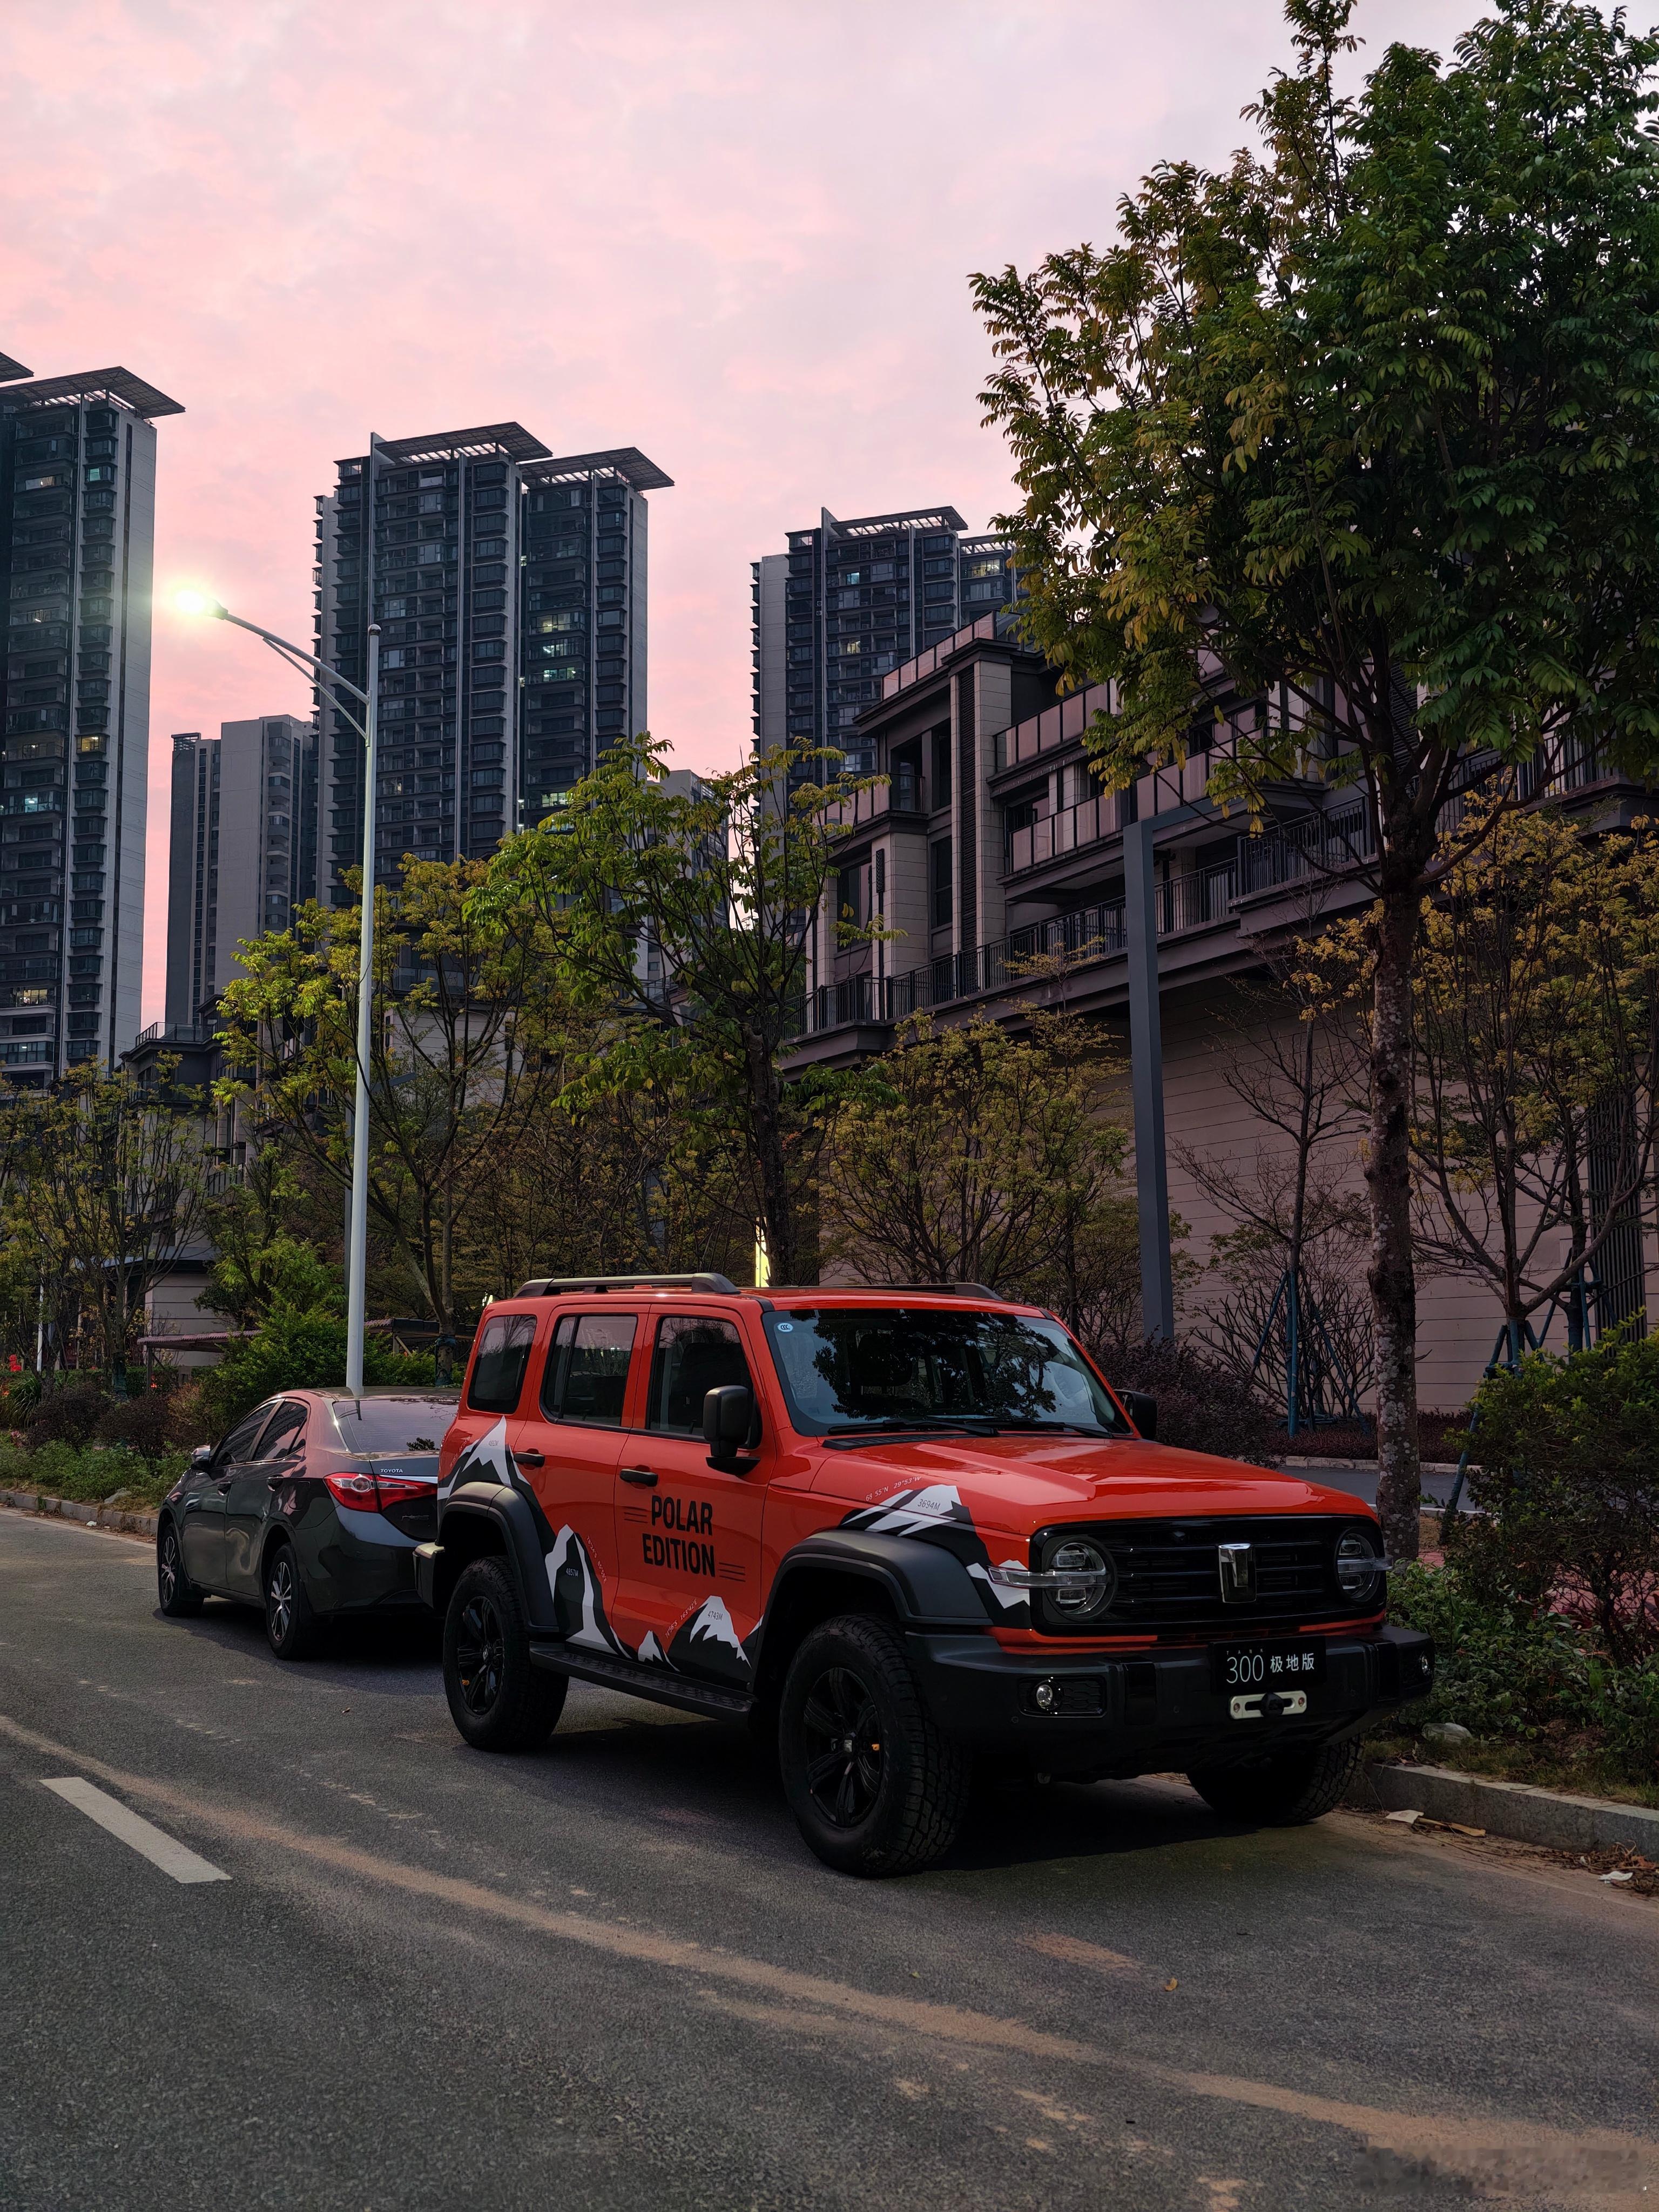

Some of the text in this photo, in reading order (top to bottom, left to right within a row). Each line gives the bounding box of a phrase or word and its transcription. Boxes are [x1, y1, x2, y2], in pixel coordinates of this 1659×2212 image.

[651, 1495, 713, 1536] POLAR
[918, 1499, 941, 1510] 3694M
[642, 1533, 716, 1577] EDITION
[707, 1610, 723, 1621] 4743M
[1226, 1653, 1314, 1684] 300 极地版
